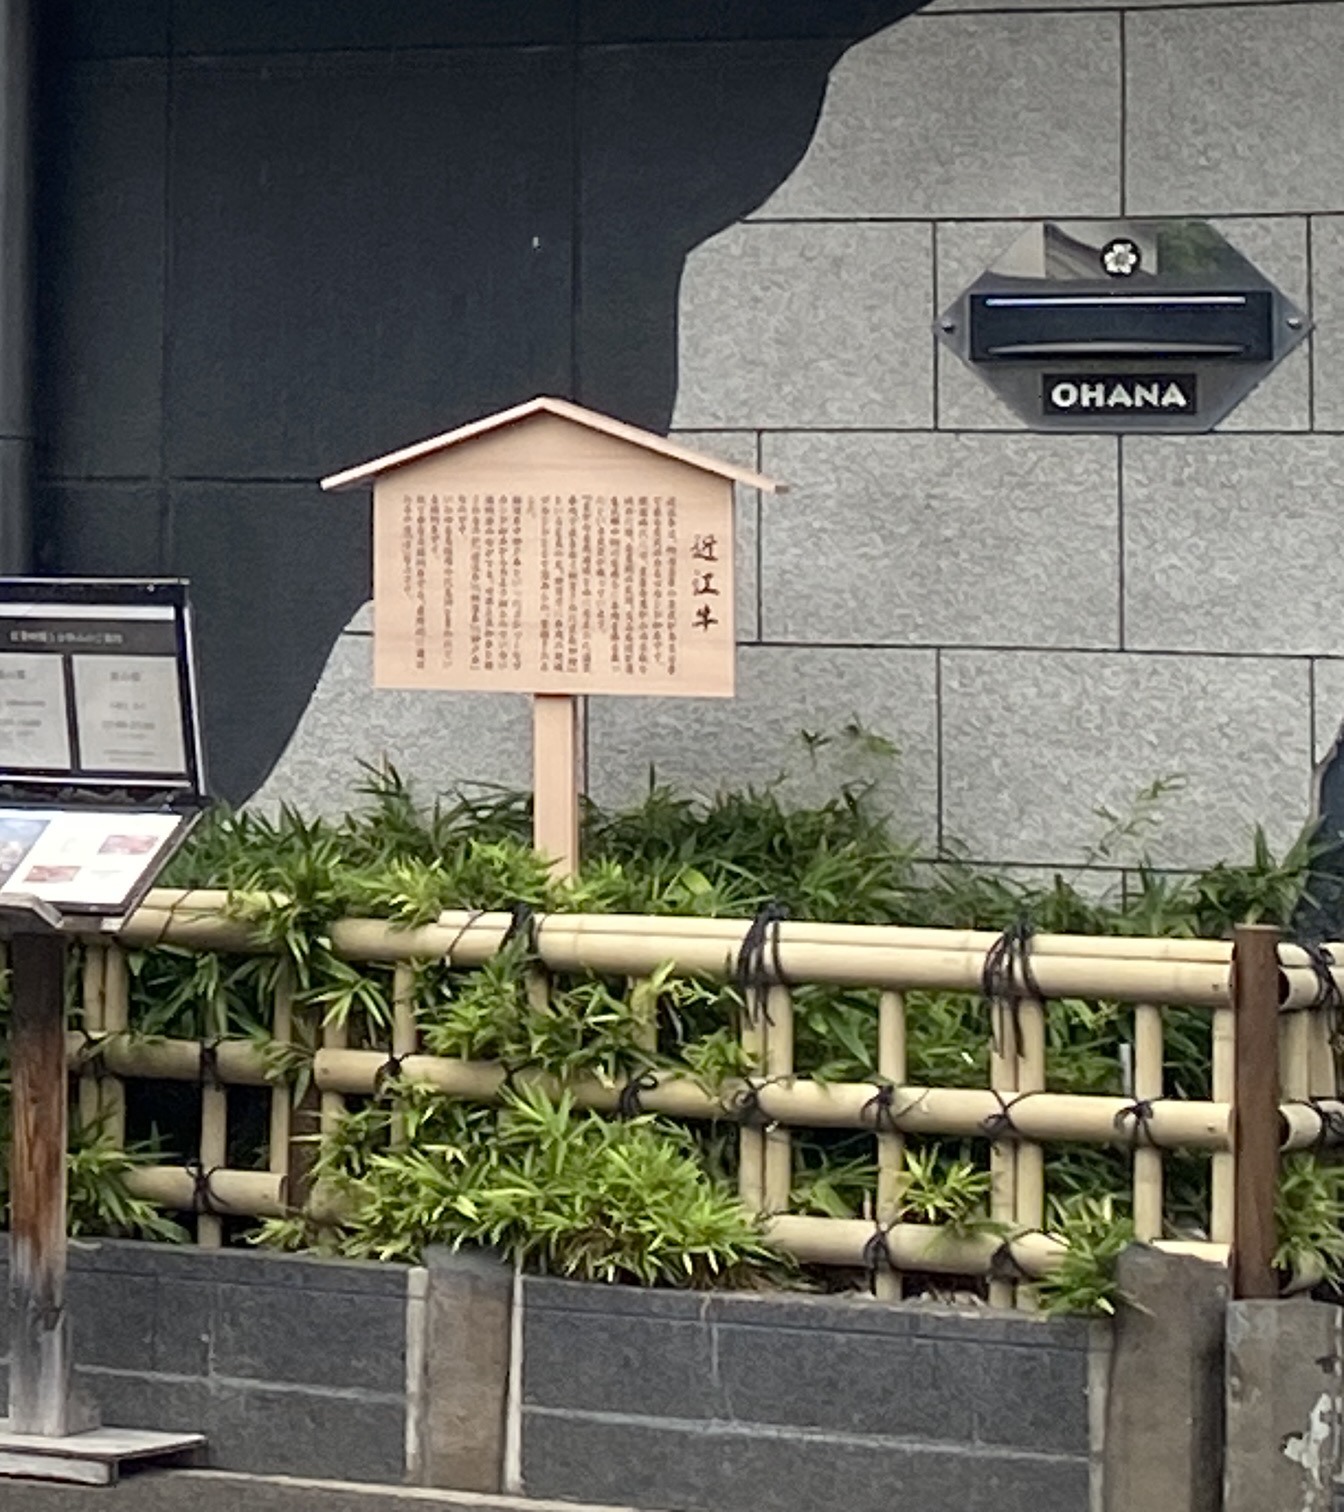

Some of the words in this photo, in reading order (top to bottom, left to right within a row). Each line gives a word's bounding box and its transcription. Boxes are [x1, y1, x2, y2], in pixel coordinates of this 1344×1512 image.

[1050, 382, 1188, 408] OHANA
[691, 533, 721, 632] 近江牛
